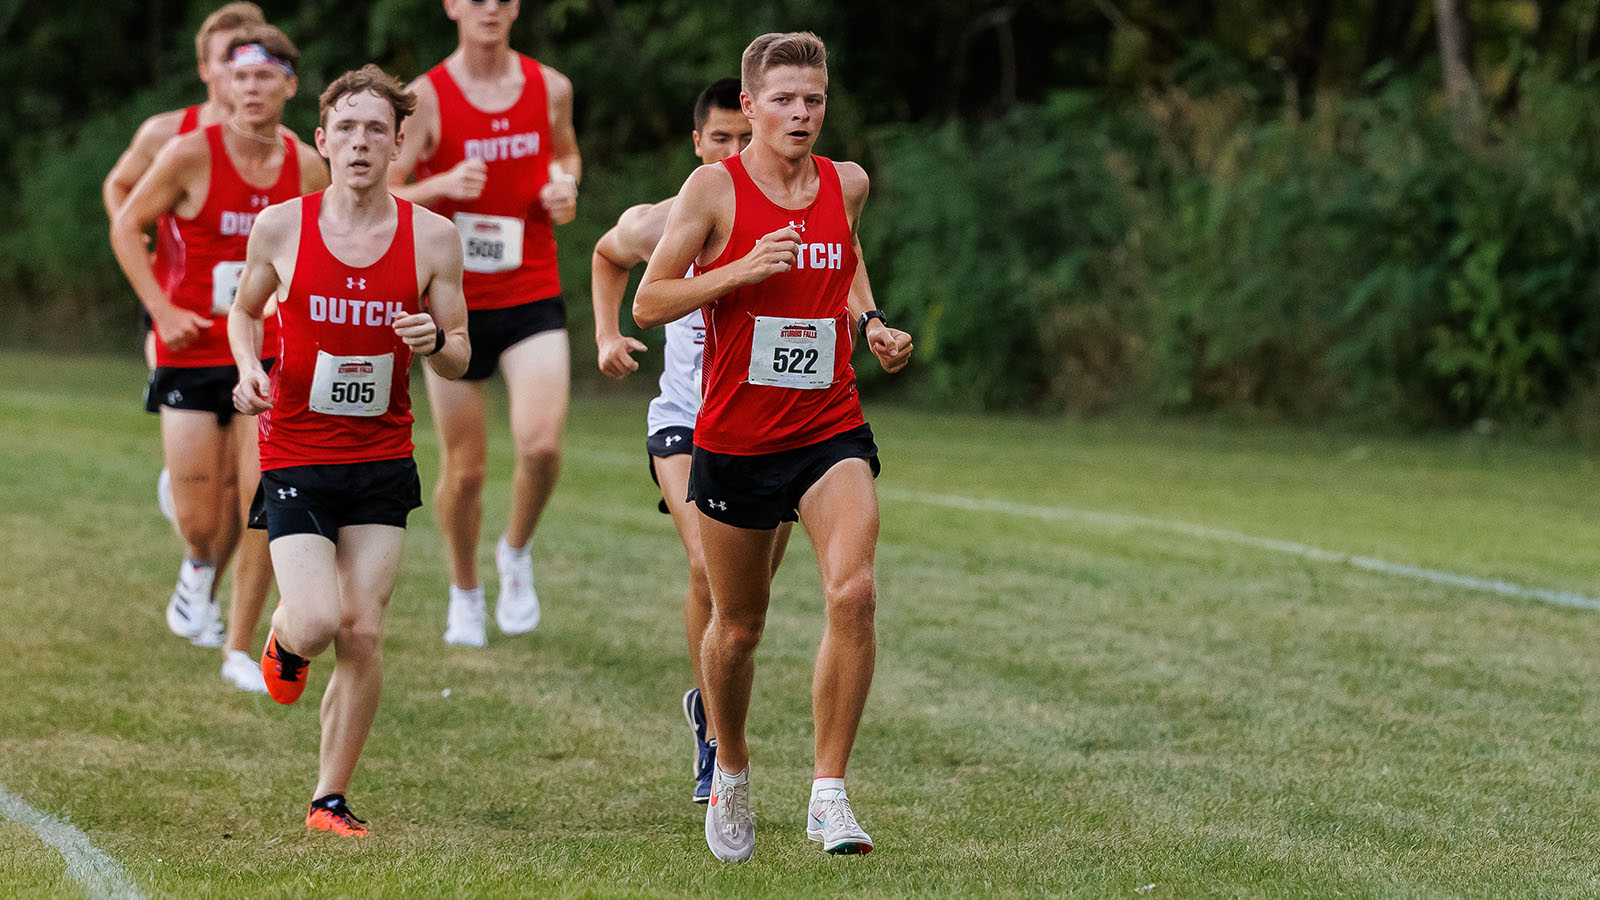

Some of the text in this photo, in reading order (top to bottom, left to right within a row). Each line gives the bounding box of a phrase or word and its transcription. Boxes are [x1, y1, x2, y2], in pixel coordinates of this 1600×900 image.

[464, 131, 540, 162] DUTCH
[309, 294, 403, 326] DUTCH
[773, 347, 819, 374] 522
[331, 382, 376, 404] 505
